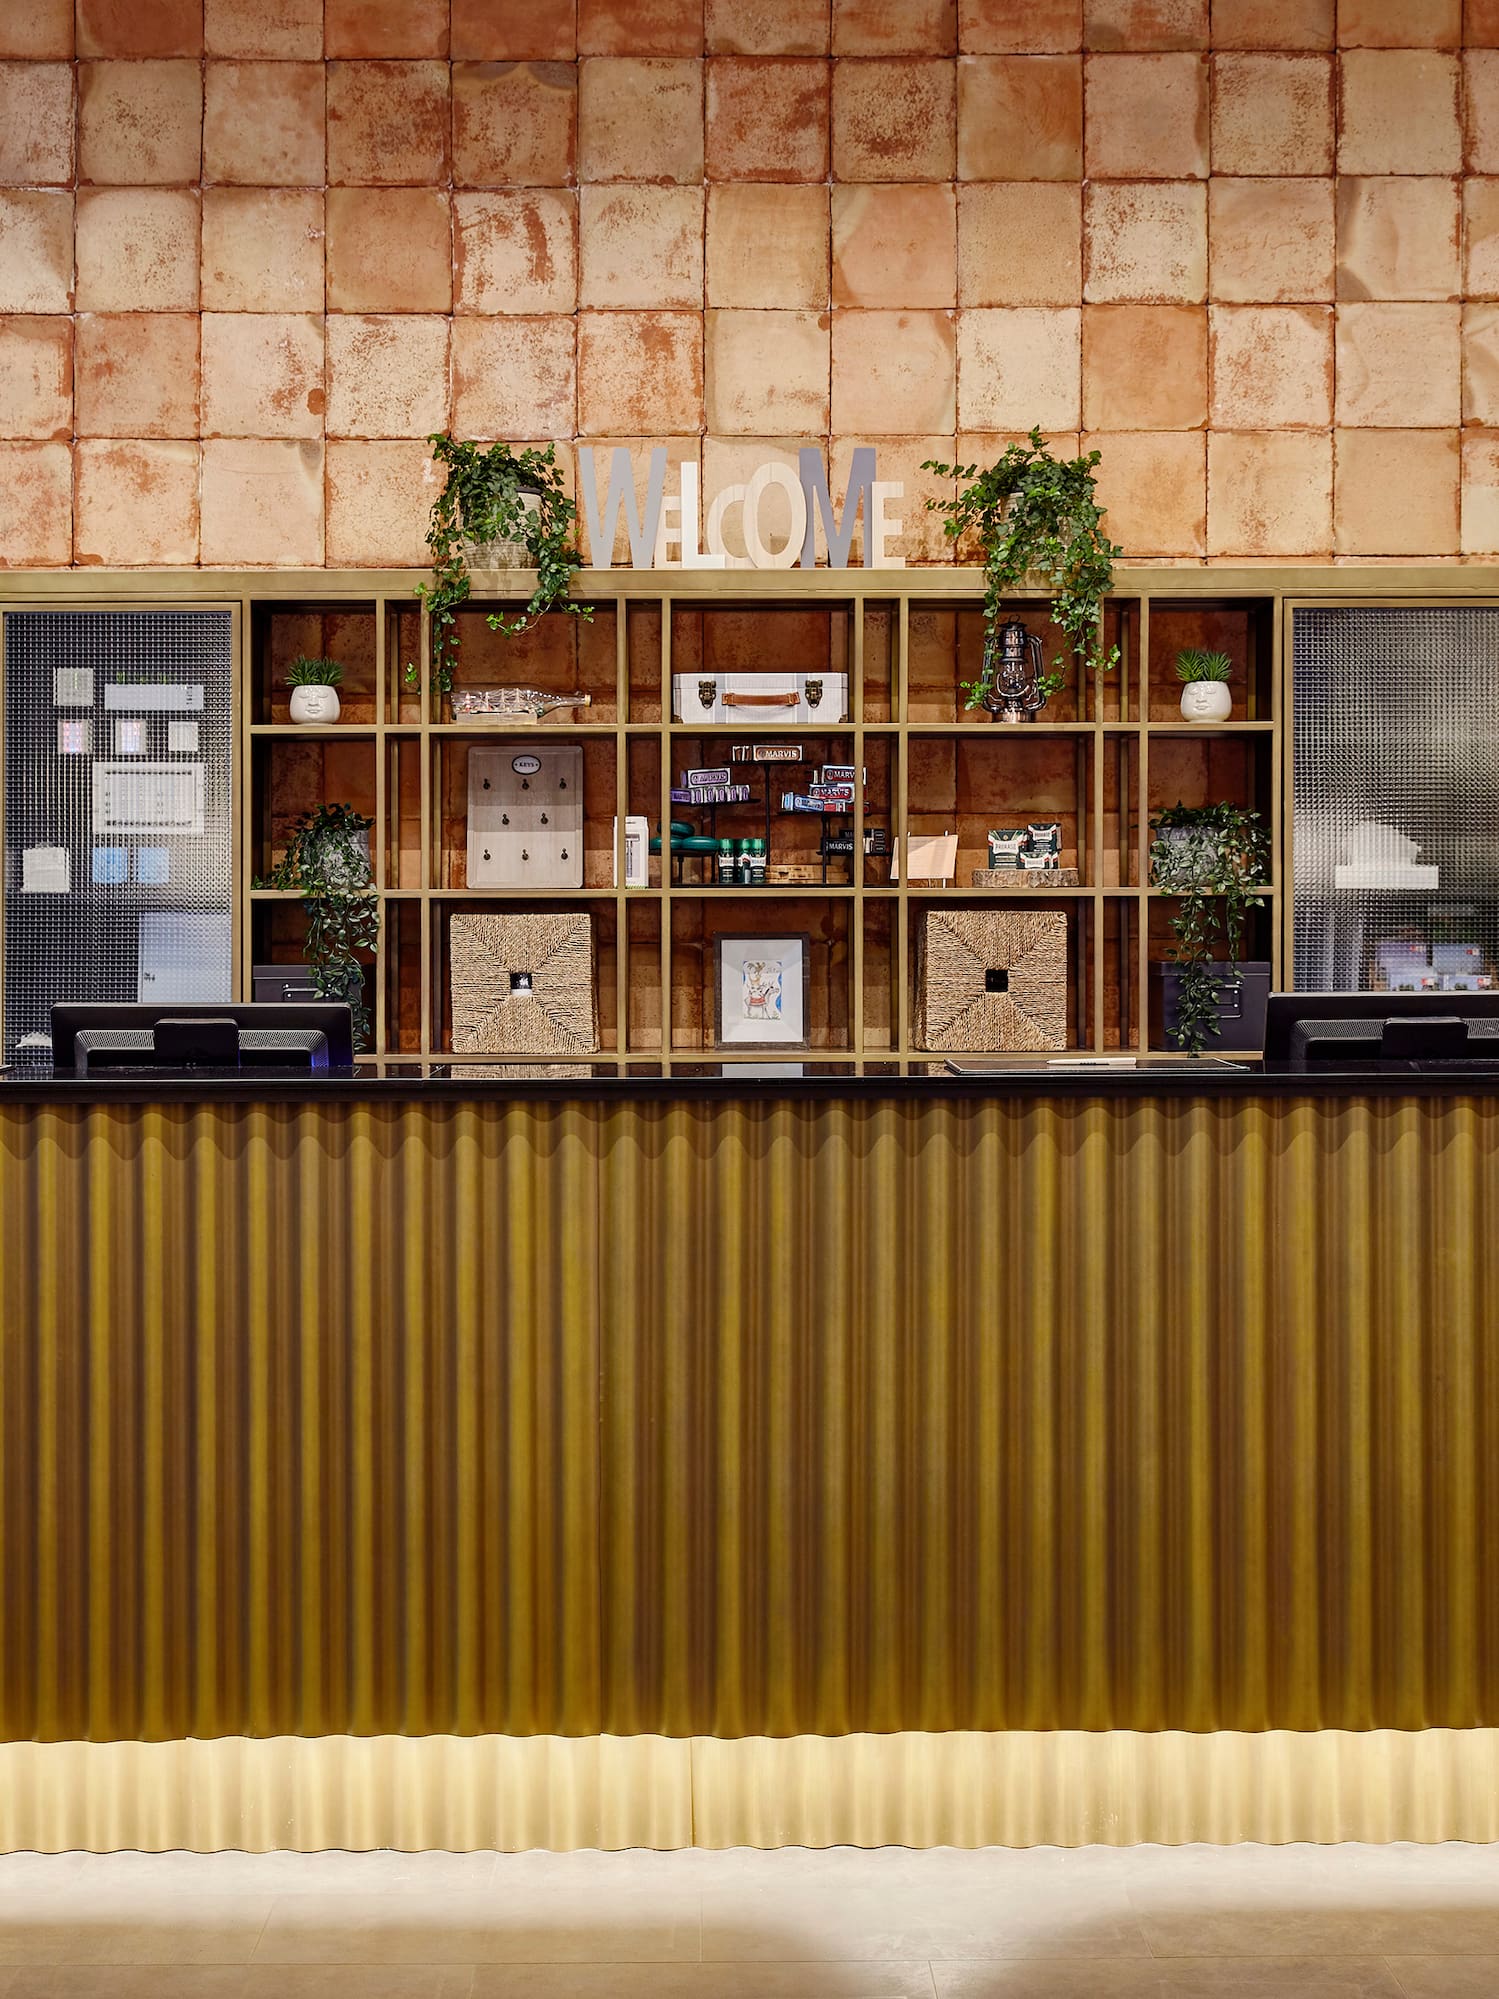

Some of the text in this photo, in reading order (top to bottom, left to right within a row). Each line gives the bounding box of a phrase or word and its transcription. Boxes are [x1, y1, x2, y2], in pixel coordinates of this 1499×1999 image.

[578, 447, 906, 568] WELCOME
[765, 750, 798, 759] MARVIS
[834, 771, 855, 779] MARV
[820, 788, 849, 797] MARVIS
[829, 842, 853, 851] MARVIS
